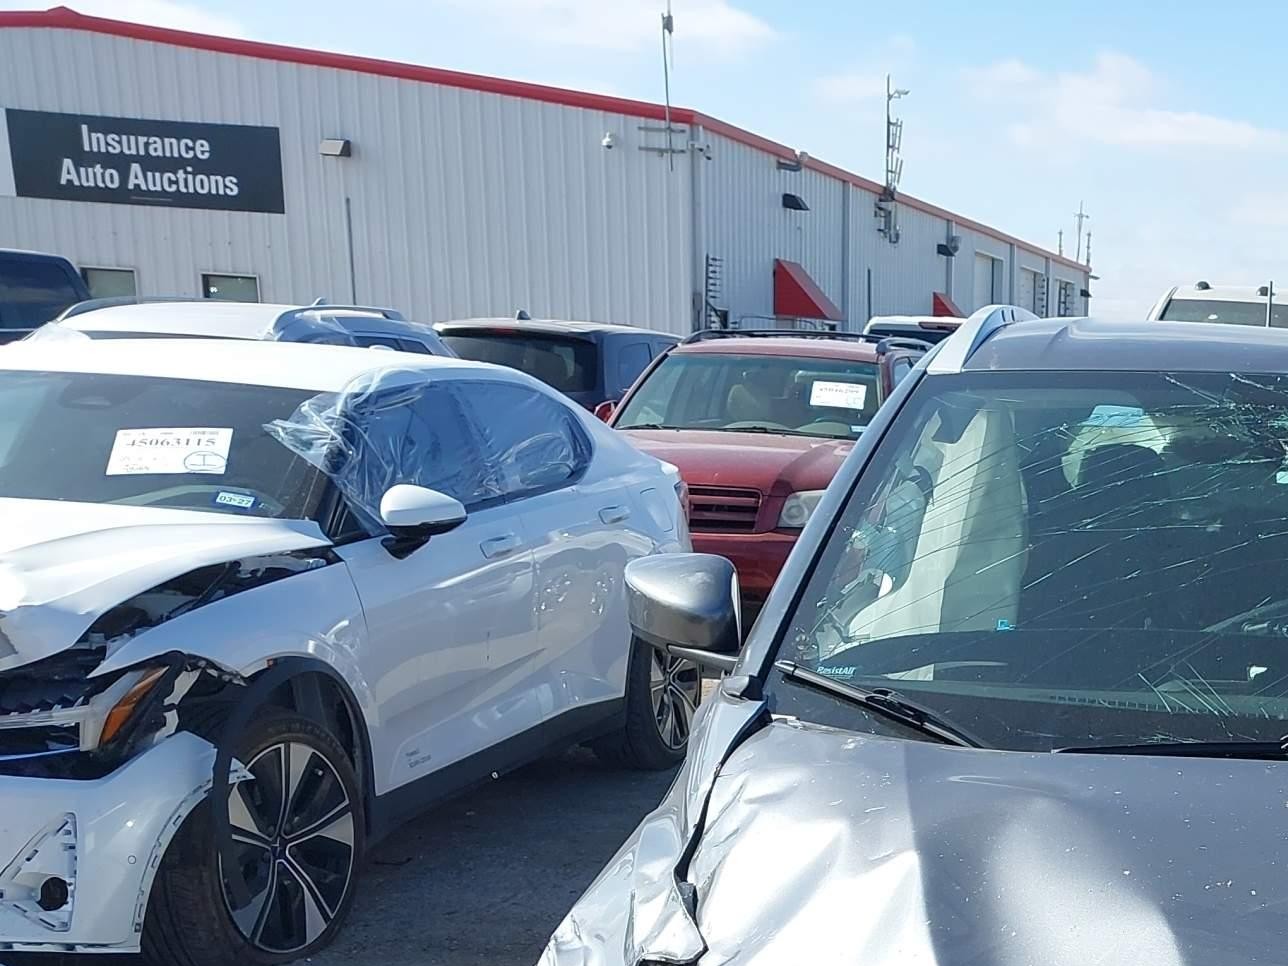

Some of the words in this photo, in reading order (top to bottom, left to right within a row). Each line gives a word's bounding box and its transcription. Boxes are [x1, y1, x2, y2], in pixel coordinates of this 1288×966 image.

[81, 124, 210, 159] Insurance
[60, 158, 120, 189] Auto
[127, 163, 239, 196] Auctions
[126, 437, 217, 448] 45063115
